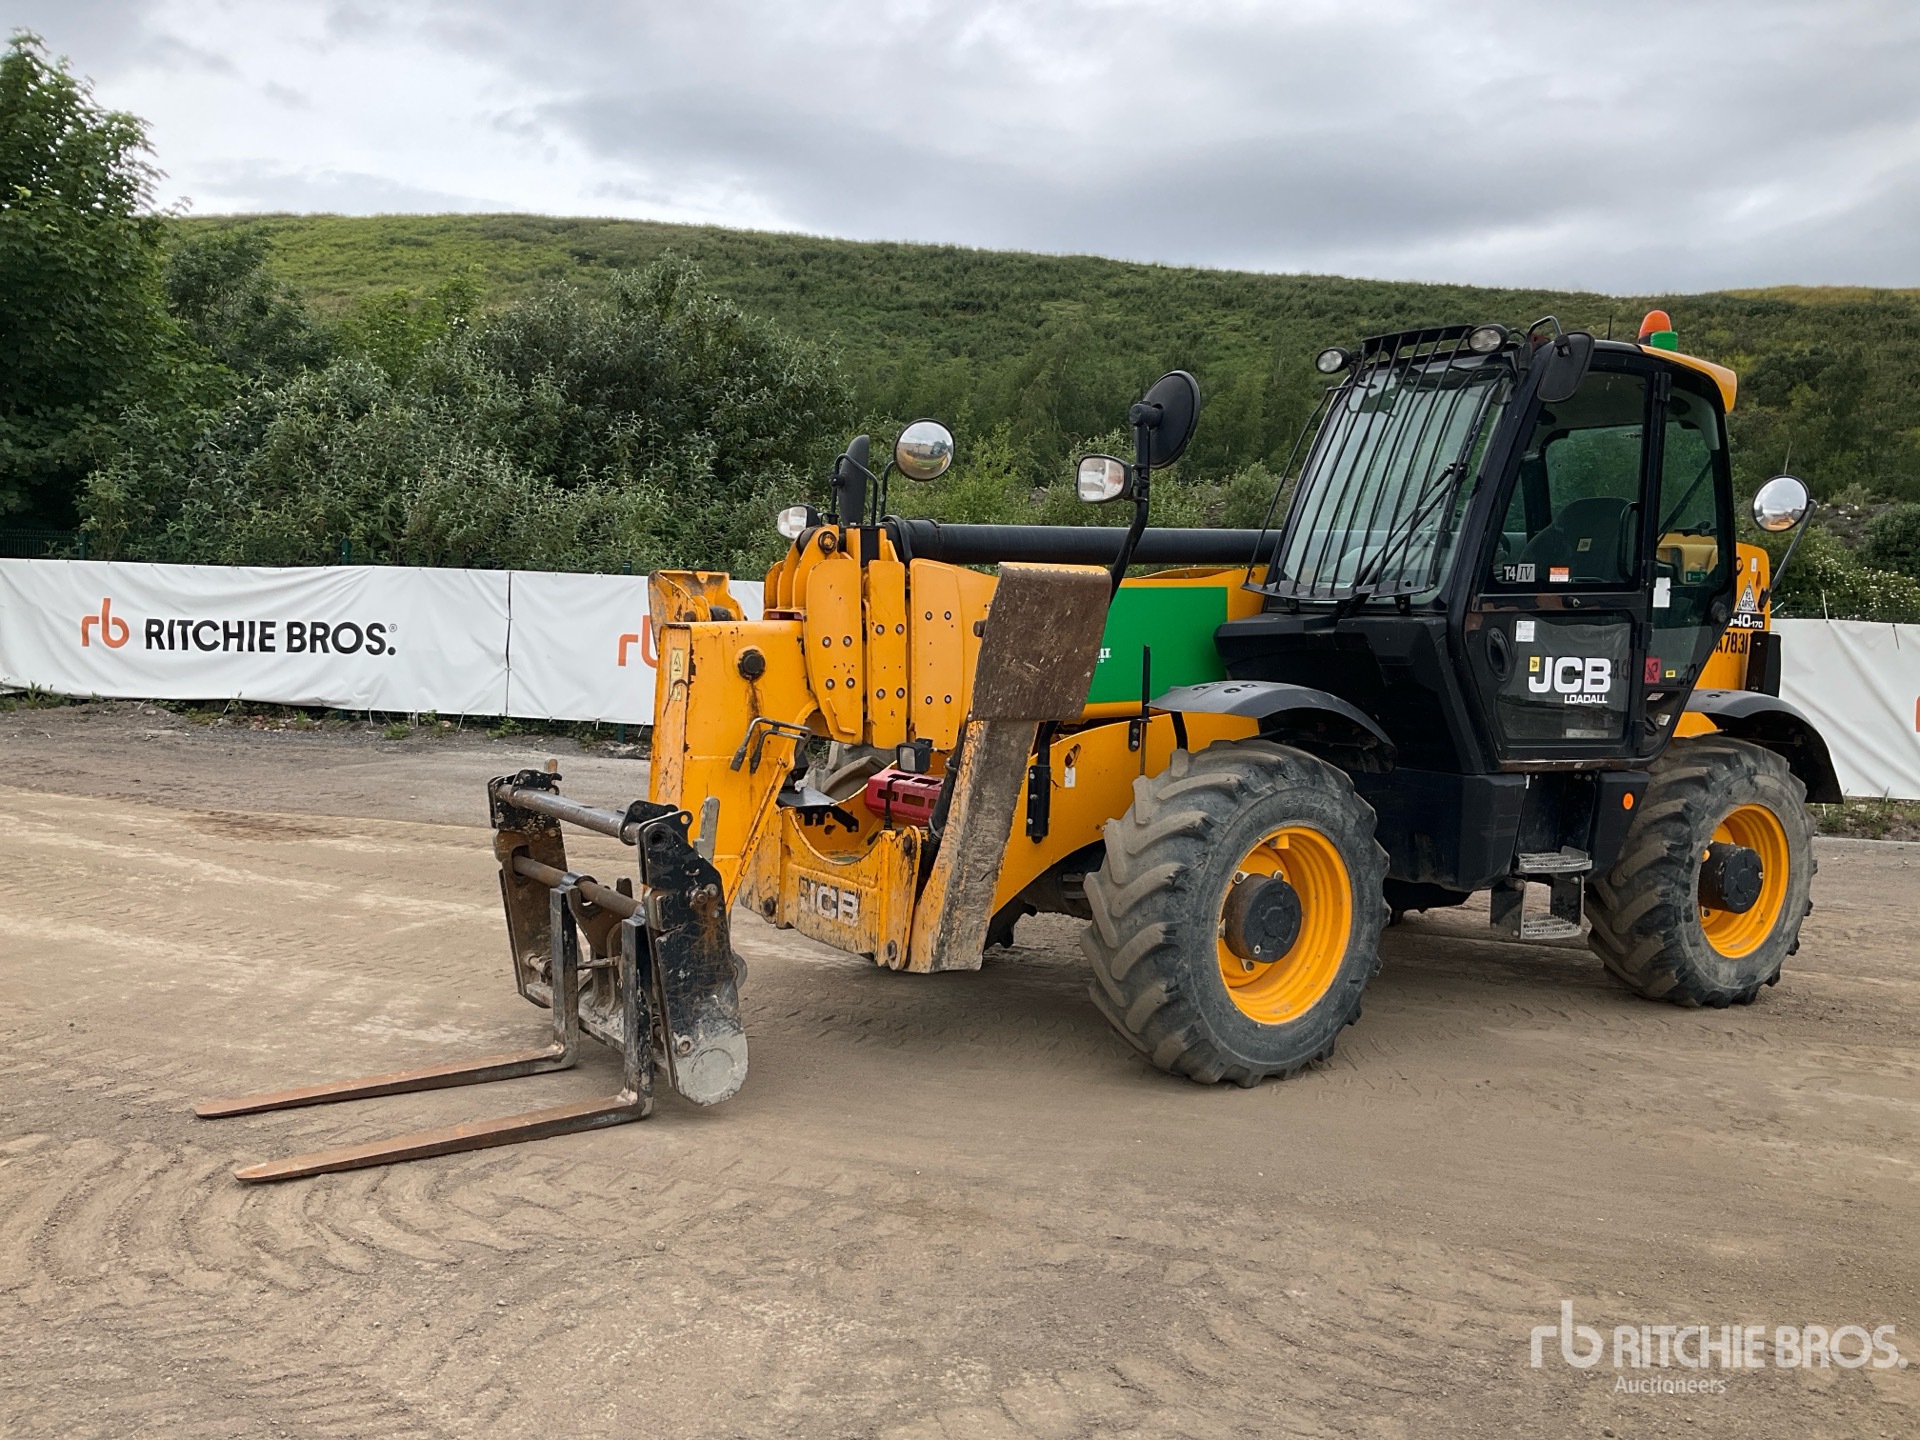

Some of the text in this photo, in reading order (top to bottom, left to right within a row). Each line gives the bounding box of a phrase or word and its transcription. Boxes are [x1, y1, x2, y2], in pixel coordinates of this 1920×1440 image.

[1503, 565, 1516, 581] T4
[1518, 566, 1533, 580] IV
[82, 598, 129, 648] rb
[145, 618, 276, 652] RITCHIE
[1528, 656, 1611, 692] JCB
[1564, 694, 1607, 704] LOADALL
